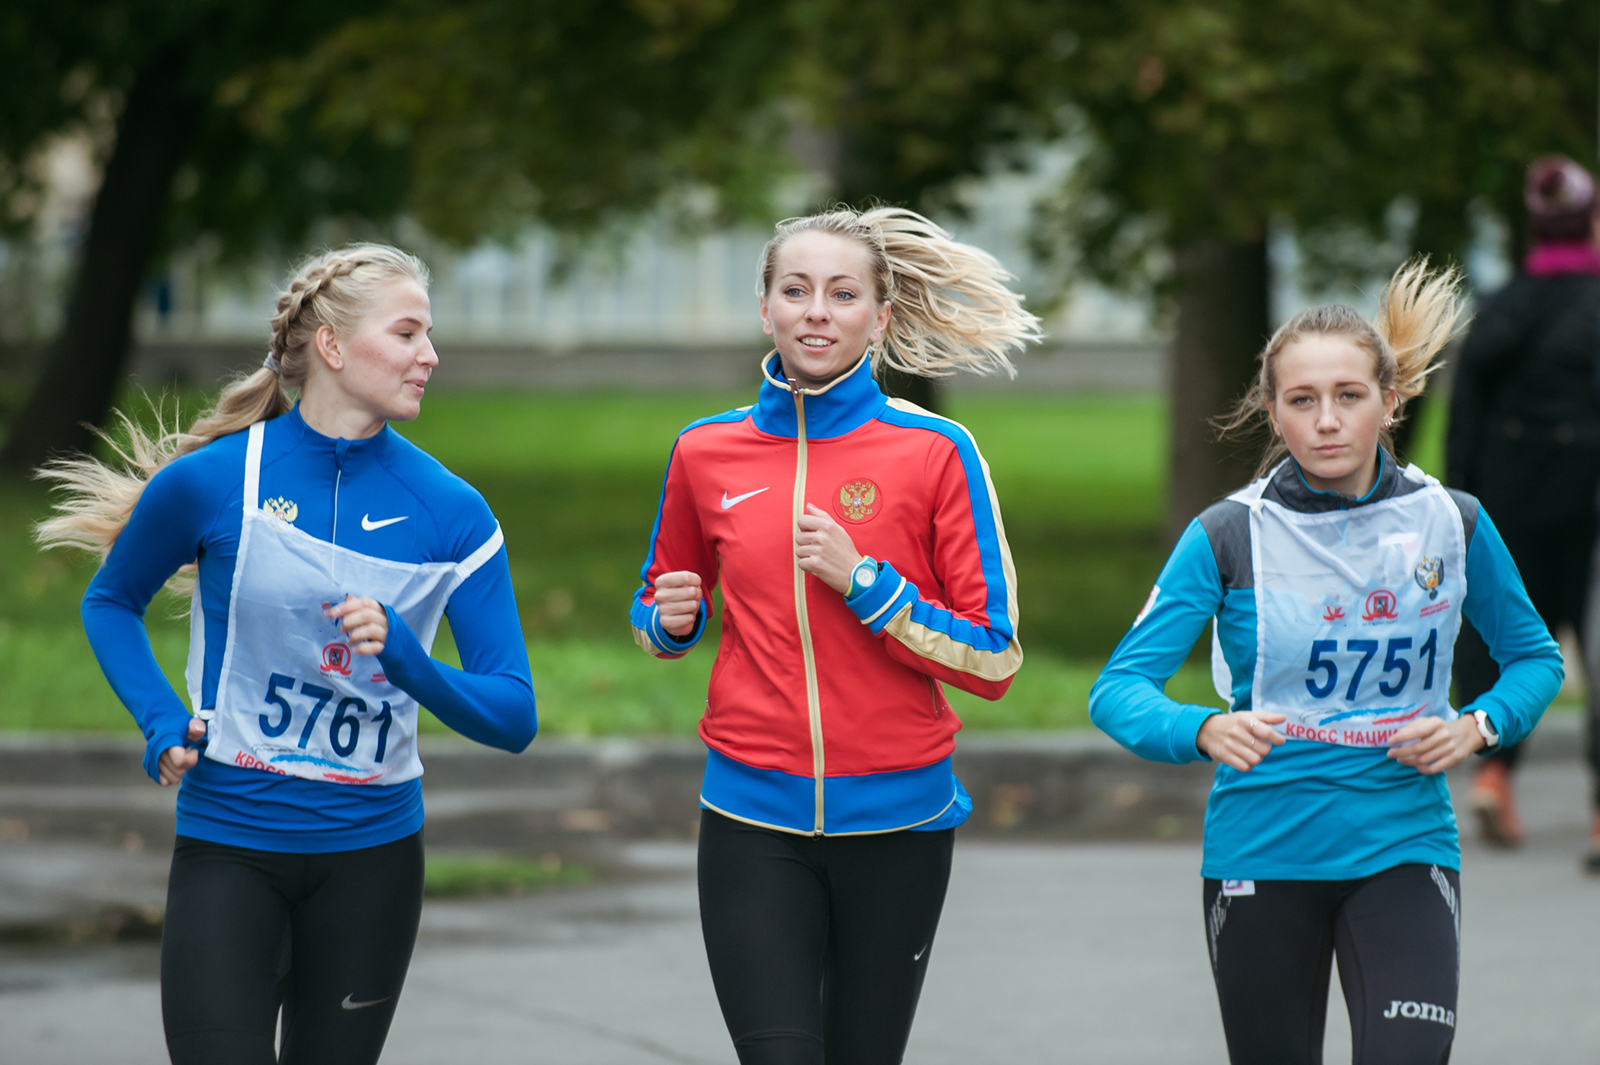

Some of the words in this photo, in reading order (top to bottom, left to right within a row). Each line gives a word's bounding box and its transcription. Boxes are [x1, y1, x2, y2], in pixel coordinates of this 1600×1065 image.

[1305, 628, 1438, 702] 5751
[258, 672, 393, 763] 5761
[1285, 722, 1338, 744] КРОСС
